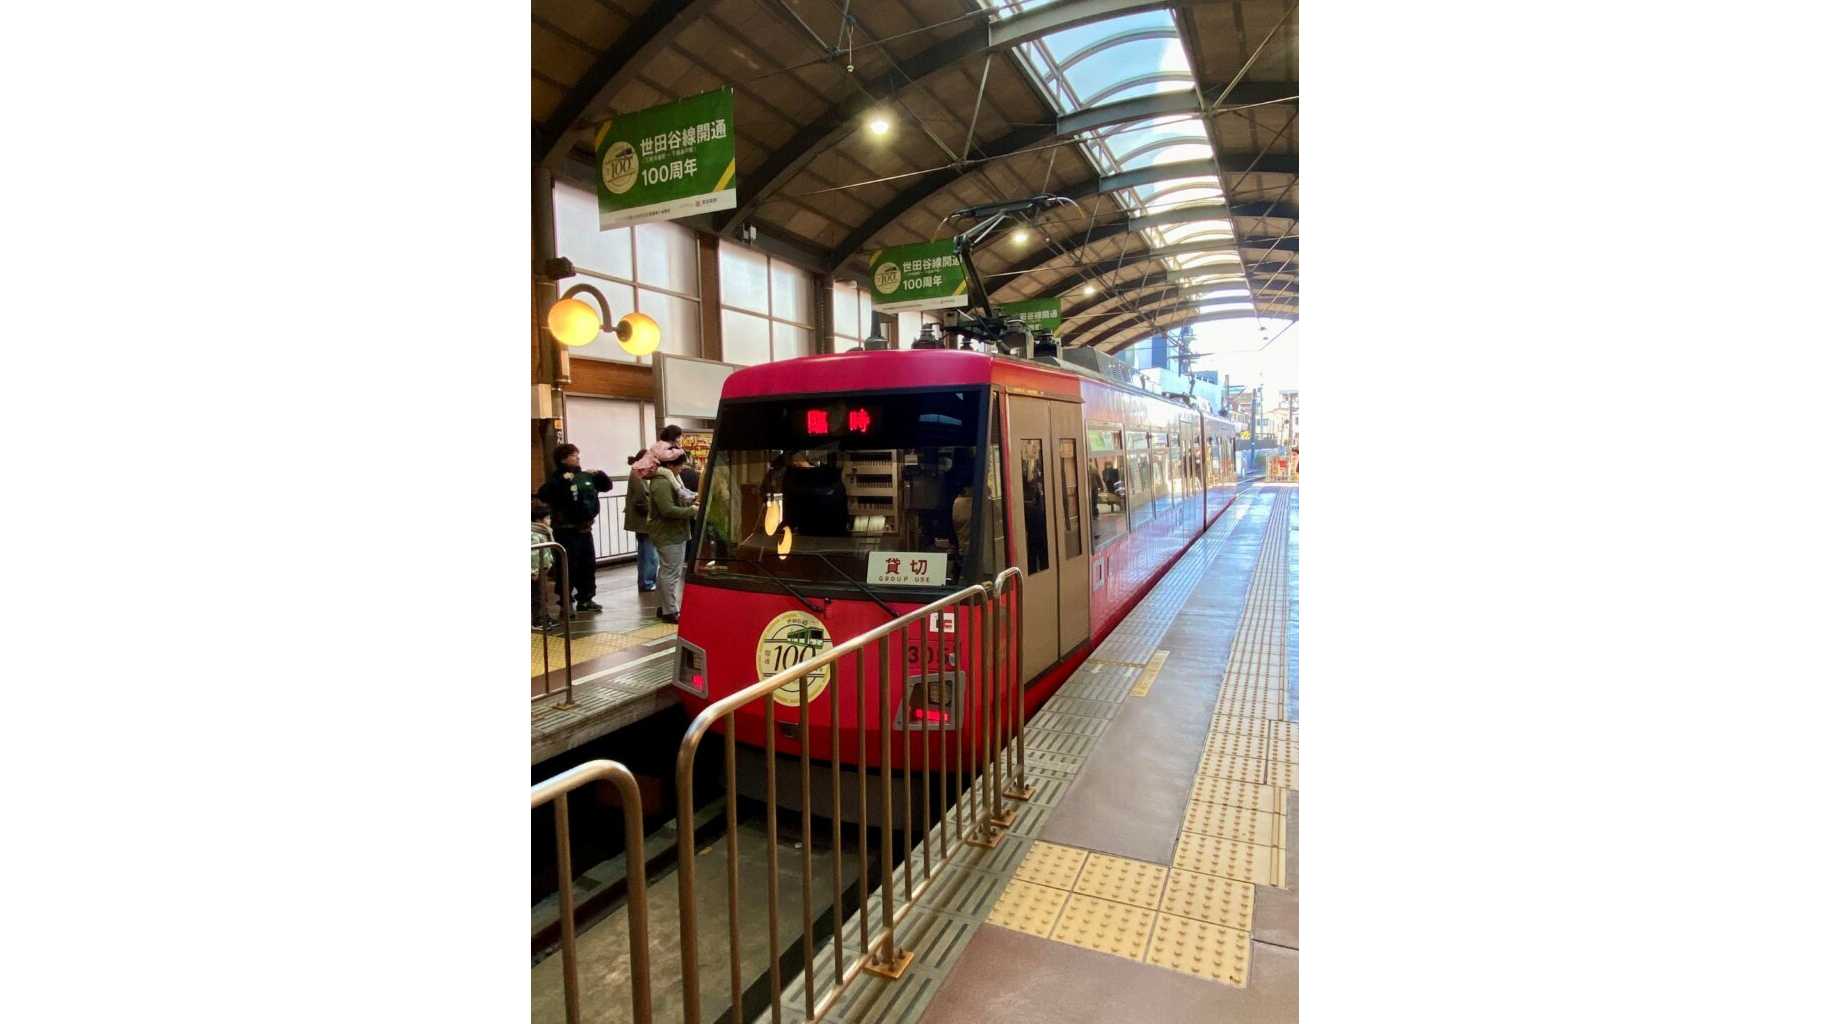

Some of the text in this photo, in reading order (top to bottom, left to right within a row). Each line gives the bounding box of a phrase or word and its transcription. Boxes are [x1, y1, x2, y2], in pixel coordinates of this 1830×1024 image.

[640, 119, 727, 156] 世田谷線開通
[641, 158, 698, 186] 100周年
[903, 275, 943, 290] 100周年
